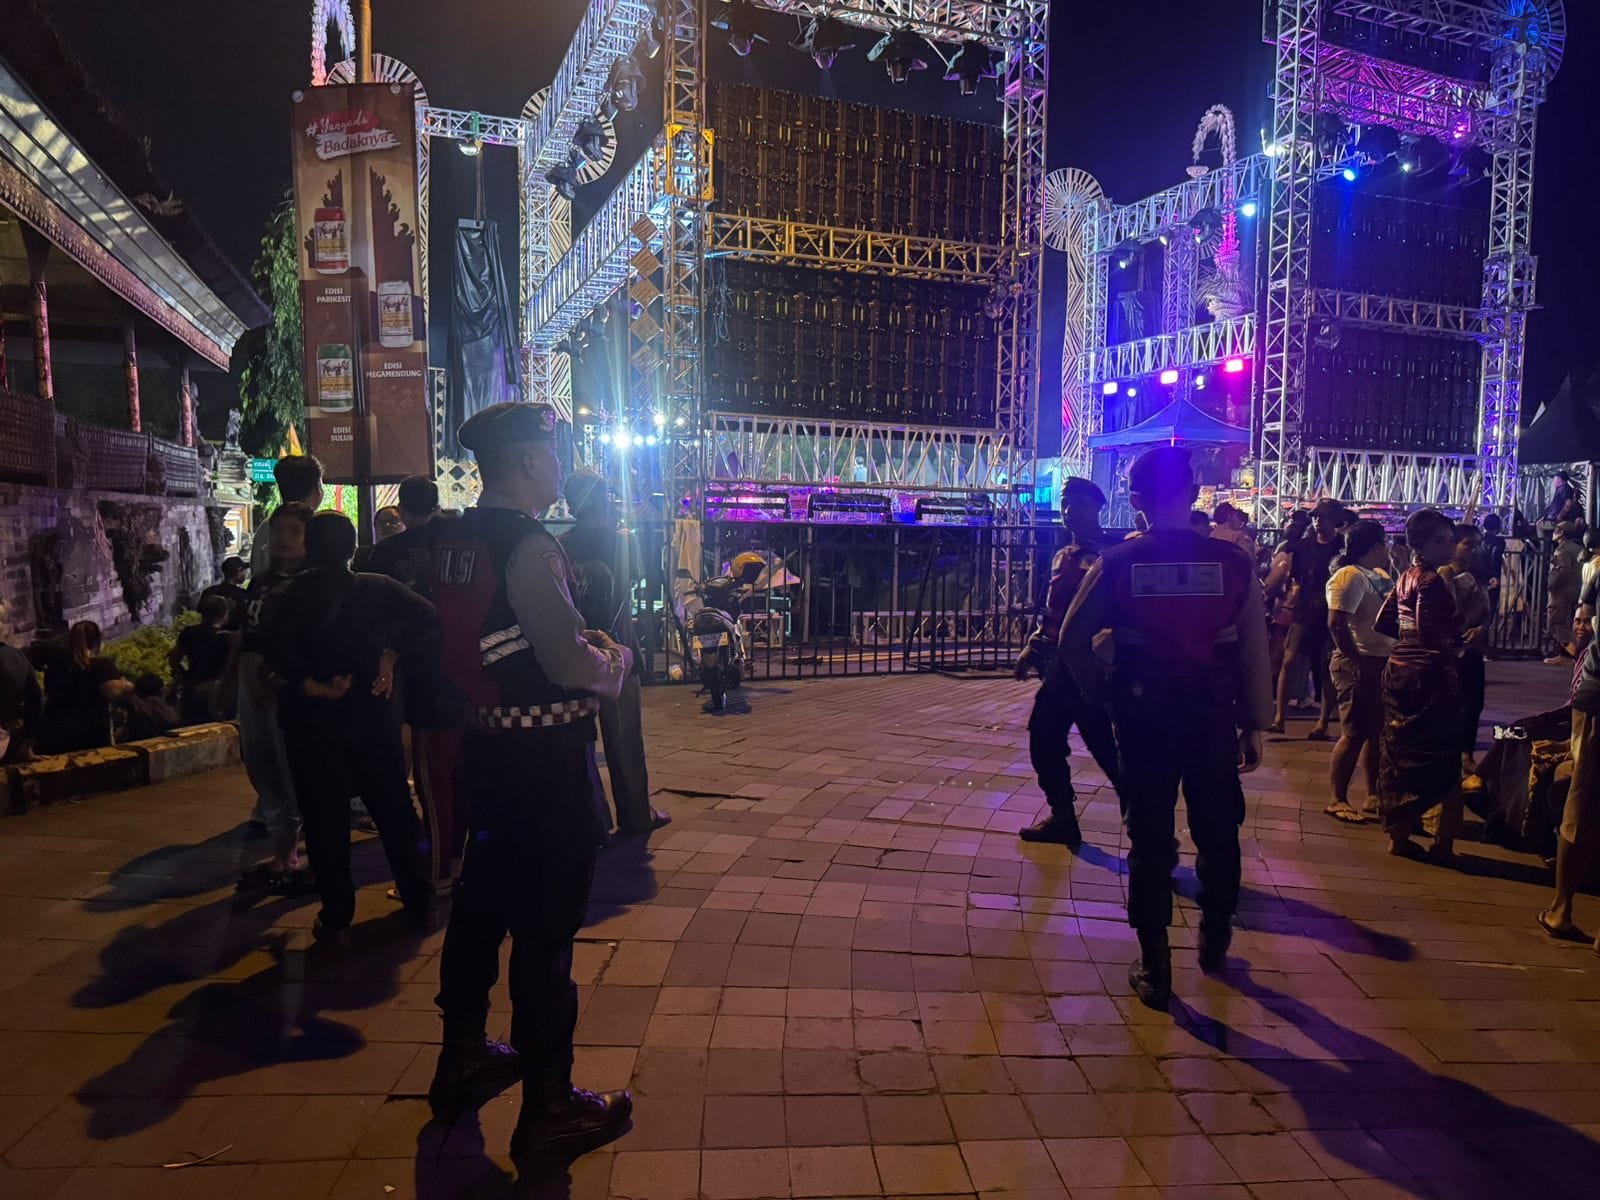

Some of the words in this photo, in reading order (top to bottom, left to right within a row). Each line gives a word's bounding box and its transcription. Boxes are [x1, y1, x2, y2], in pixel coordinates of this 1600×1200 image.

[324, 134, 388, 154] Badaknya
[325, 287, 343, 295] EDISI
[316, 295, 351, 303] PARIKESIT
[365, 370, 422, 378] MEGAMENDUNG
[330, 434, 354, 442] SULUR
